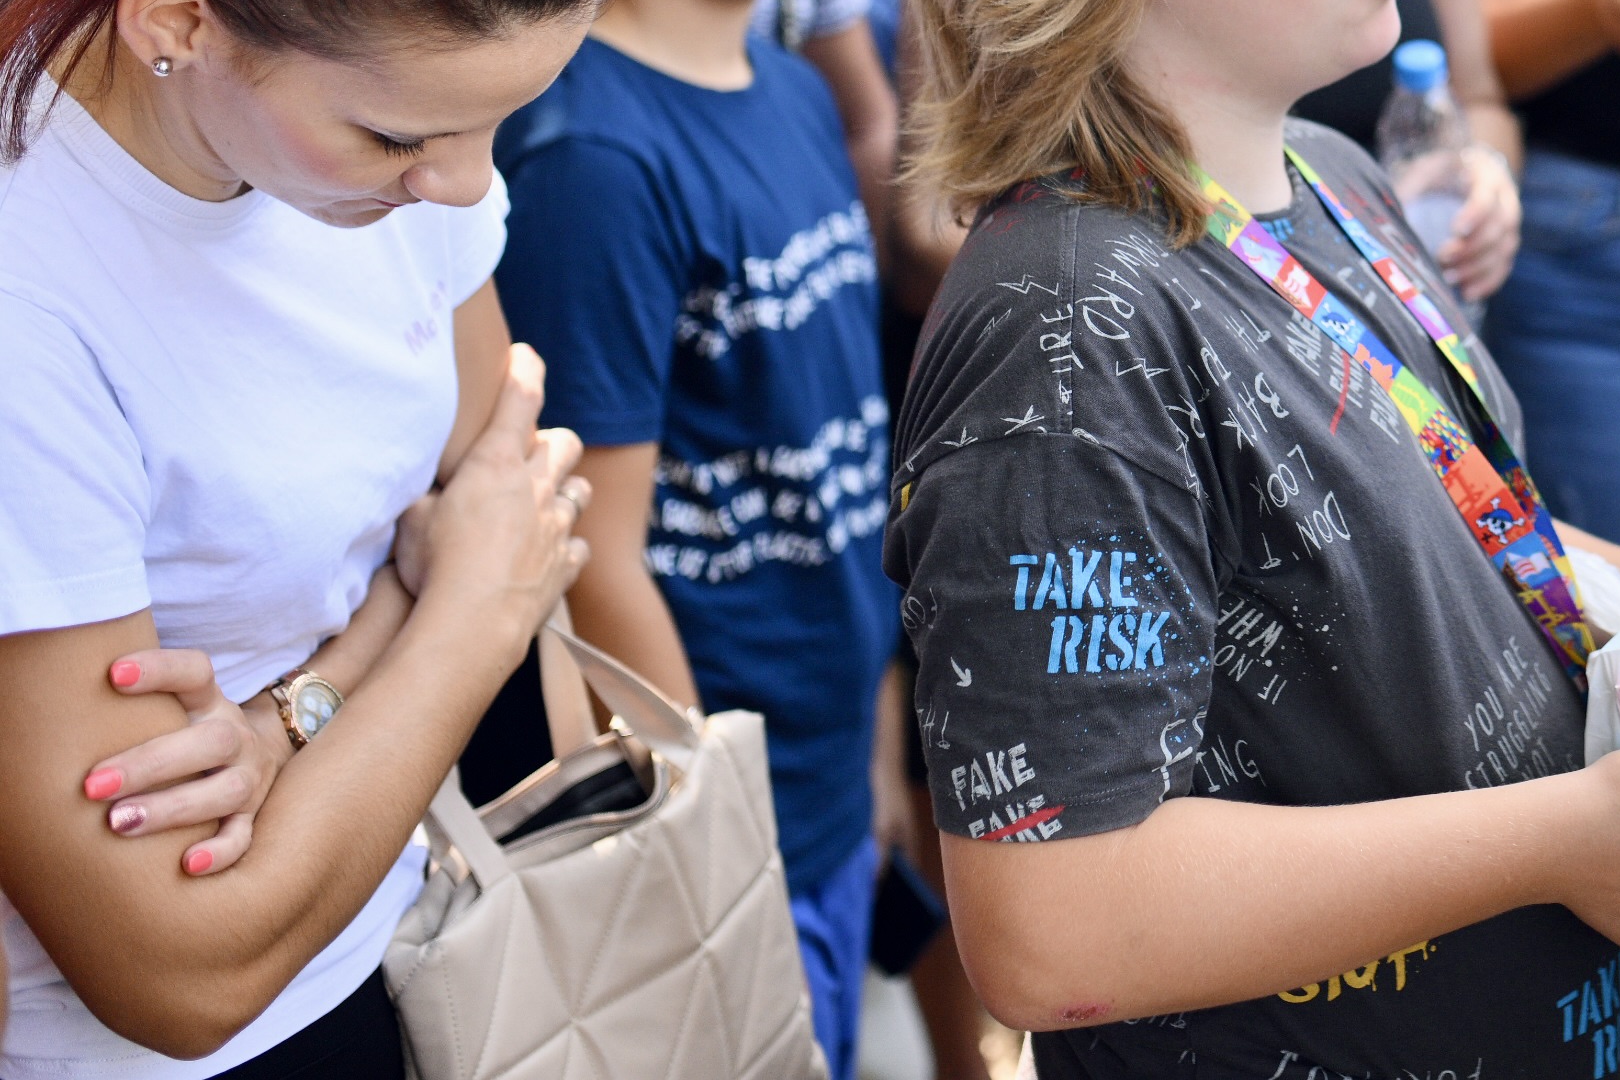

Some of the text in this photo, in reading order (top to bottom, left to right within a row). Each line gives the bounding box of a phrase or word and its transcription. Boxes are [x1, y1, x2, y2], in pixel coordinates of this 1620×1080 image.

[1220, 372, 1290, 452] BACK
[1249, 444, 1315, 518] LOOK
[1258, 490, 1352, 572] DON'T
[1009, 549, 1140, 612] TAKE
[1046, 610, 1172, 675] RISK
[1463, 683, 1506, 753] YOU
[950, 742, 1036, 812] FAKE
